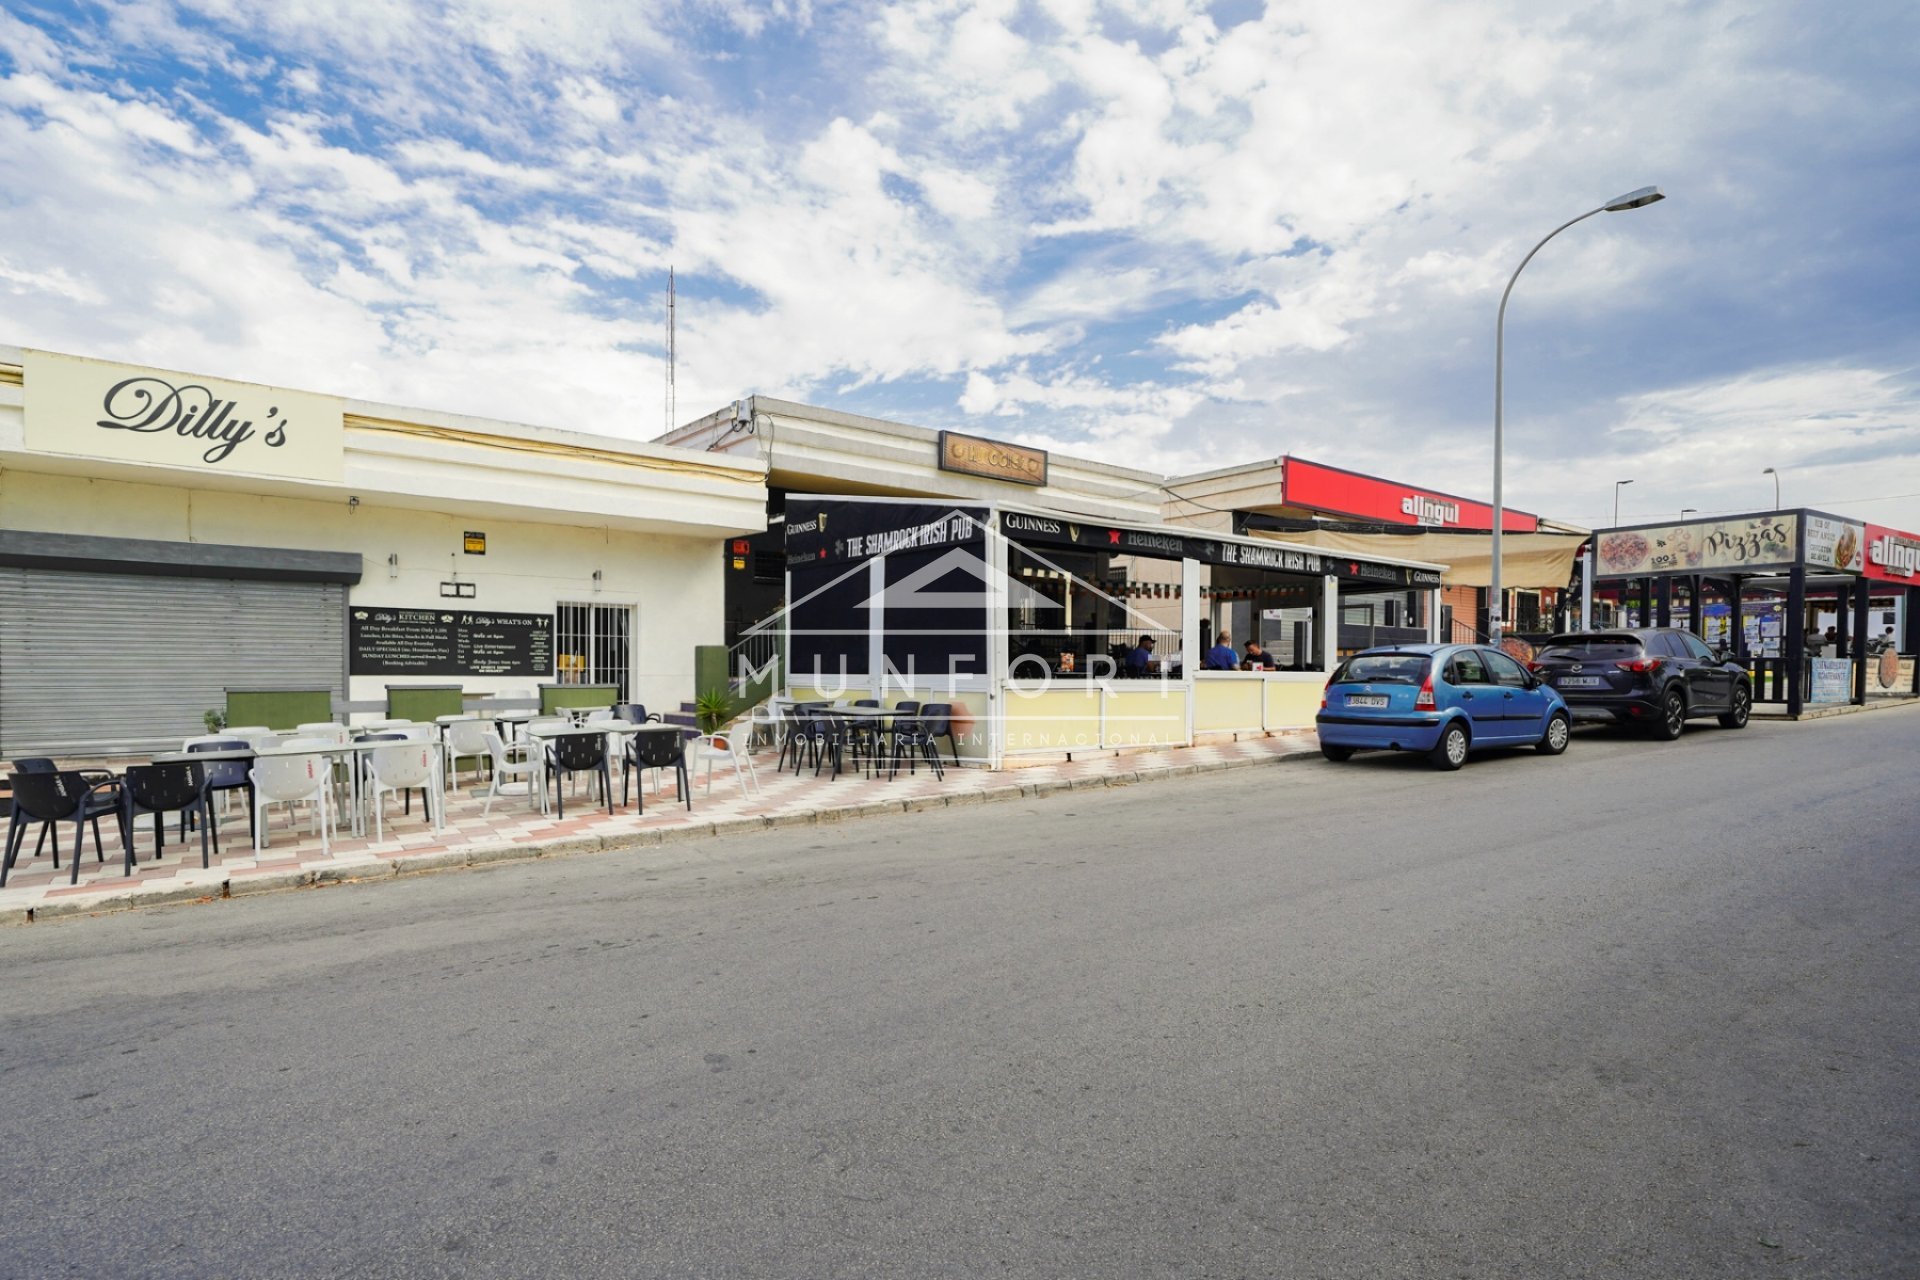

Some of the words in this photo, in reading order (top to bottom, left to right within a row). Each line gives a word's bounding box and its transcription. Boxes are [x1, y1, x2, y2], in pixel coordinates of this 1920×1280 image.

[96, 377, 287, 463] Dilly's
[1402, 495, 1459, 526] alingul
[786, 519, 817, 535] GUINNESS
[1006, 513, 1060, 534] GUINNESS
[847, 537, 863, 558] THE
[866, 527, 918, 555] SHAMROCK
[919, 521, 947, 546] IRISH
[951, 516, 973, 541] PUB
[1128, 533, 1183, 552] Heineken
[1703, 523, 1791, 561] Pizzas
[1221, 543, 1238, 564] THE
[1240, 546, 1284, 568] SHAMROCK
[1285, 551, 1304, 570] IRISH
[1306, 554, 1321, 572] PUB
[1361, 563, 1396, 581] Heineken
[1413, 570, 1440, 584] GUINNESS
